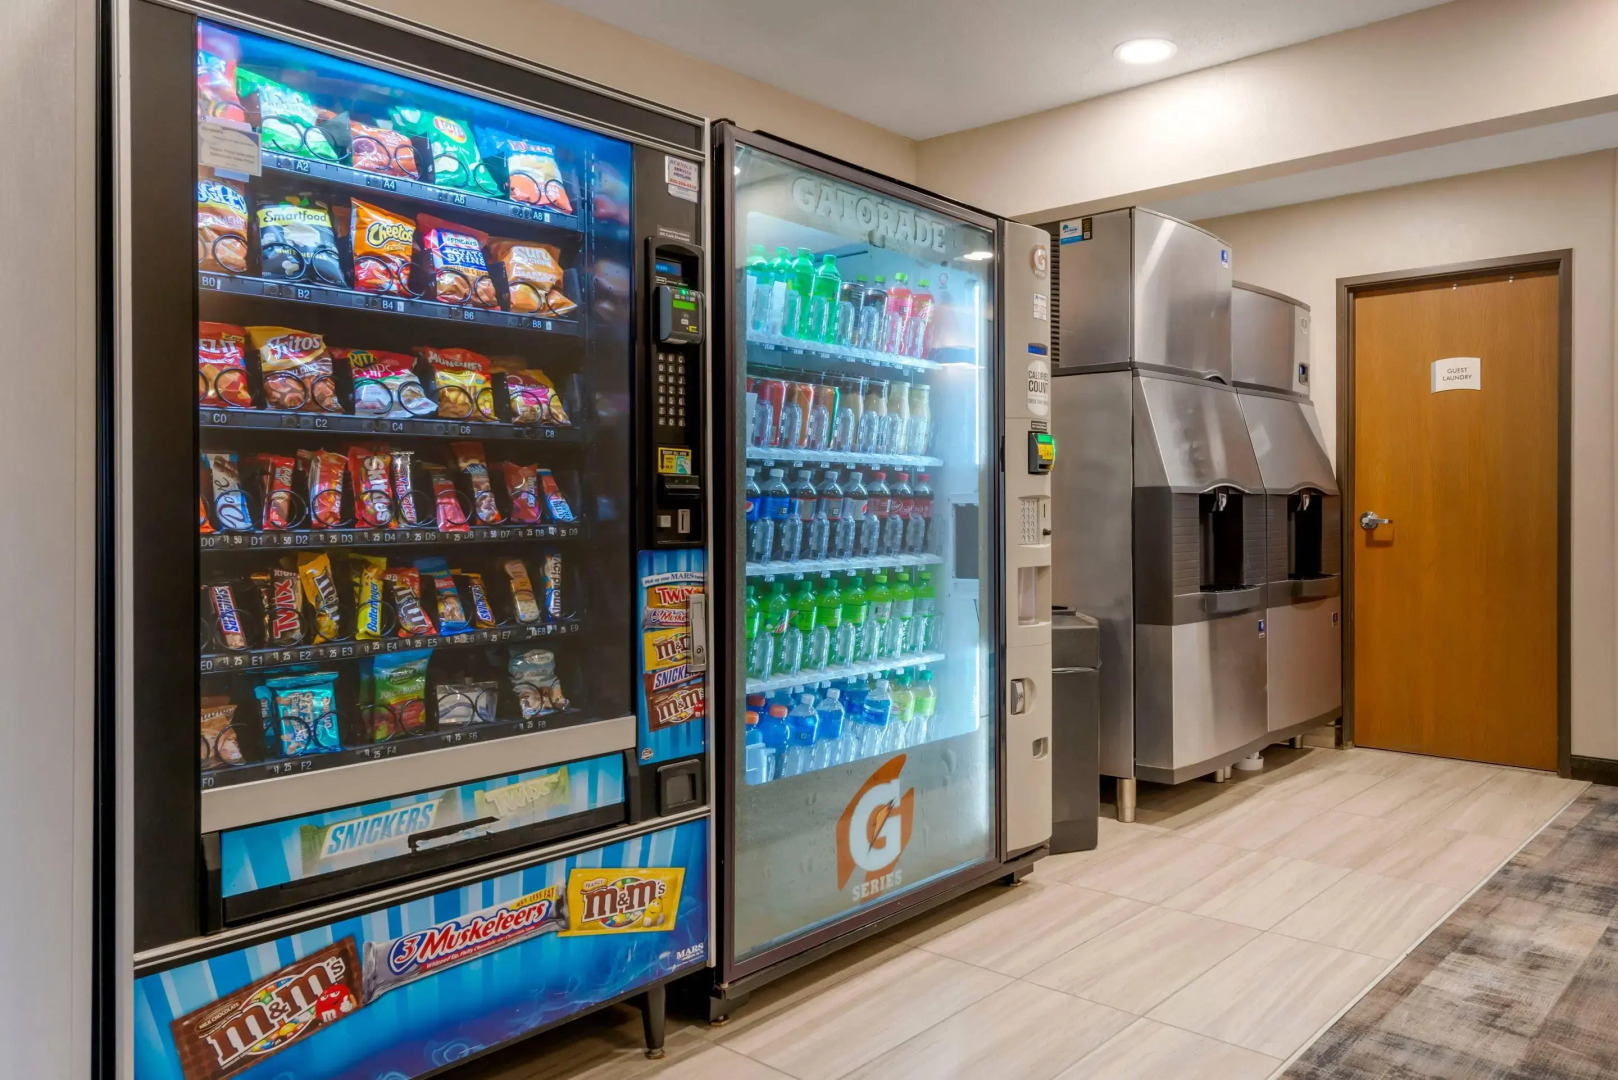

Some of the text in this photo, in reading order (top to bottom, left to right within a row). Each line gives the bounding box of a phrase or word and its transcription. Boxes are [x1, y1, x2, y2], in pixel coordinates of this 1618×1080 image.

[263, 210, 326, 223] Smartfood
[793, 177, 946, 252] GATORADE
[368, 222, 413, 246] Cheetos
[447, 254, 486, 266] SKINS
[202, 277, 216, 287] B0
[298, 289, 310, 299] B2
[382, 301, 393, 310] B4
[464, 311, 474, 320] B6
[267, 335, 321, 360] Fritos
[213, 413, 227, 423] C0
[315, 419, 328, 428] C2
[392, 422, 403, 431] C4
[460, 426, 471, 434] C6
[364, 456, 391, 522] Skittles
[200, 537, 215, 547] D0
[295, 535, 308, 544] D2
[341, 534, 353, 543] D3
[384, 533, 396, 541] D4
[671, 572, 694, 580] MARS
[273, 579, 300, 639] TWIX
[387, 642, 397, 651] E4
[427, 639, 438, 647] E5
[300, 651, 311, 660] E2
[341, 647, 353, 656] E3
[200, 660, 213, 670] E0
[252, 656, 263, 665] E1
[301, 761, 312, 770] F2
[202, 777, 214, 787] F0
[849, 777, 902, 871] G
[326, 803, 437, 856] SNICKERS
[584, 877, 605, 890] PEANUT
[852, 869, 903, 901] SERIES
[529, 891, 543, 902] LESS
[543, 886, 555, 899] FAT
[583, 877, 667, 922] m&m's
[395, 902, 546, 964] 3 Musketeers
[676, 942, 704, 960] MARS
[199, 1002, 240, 1030] MILK CHOCOLATE
[206, 957, 346, 1066] m&m's
